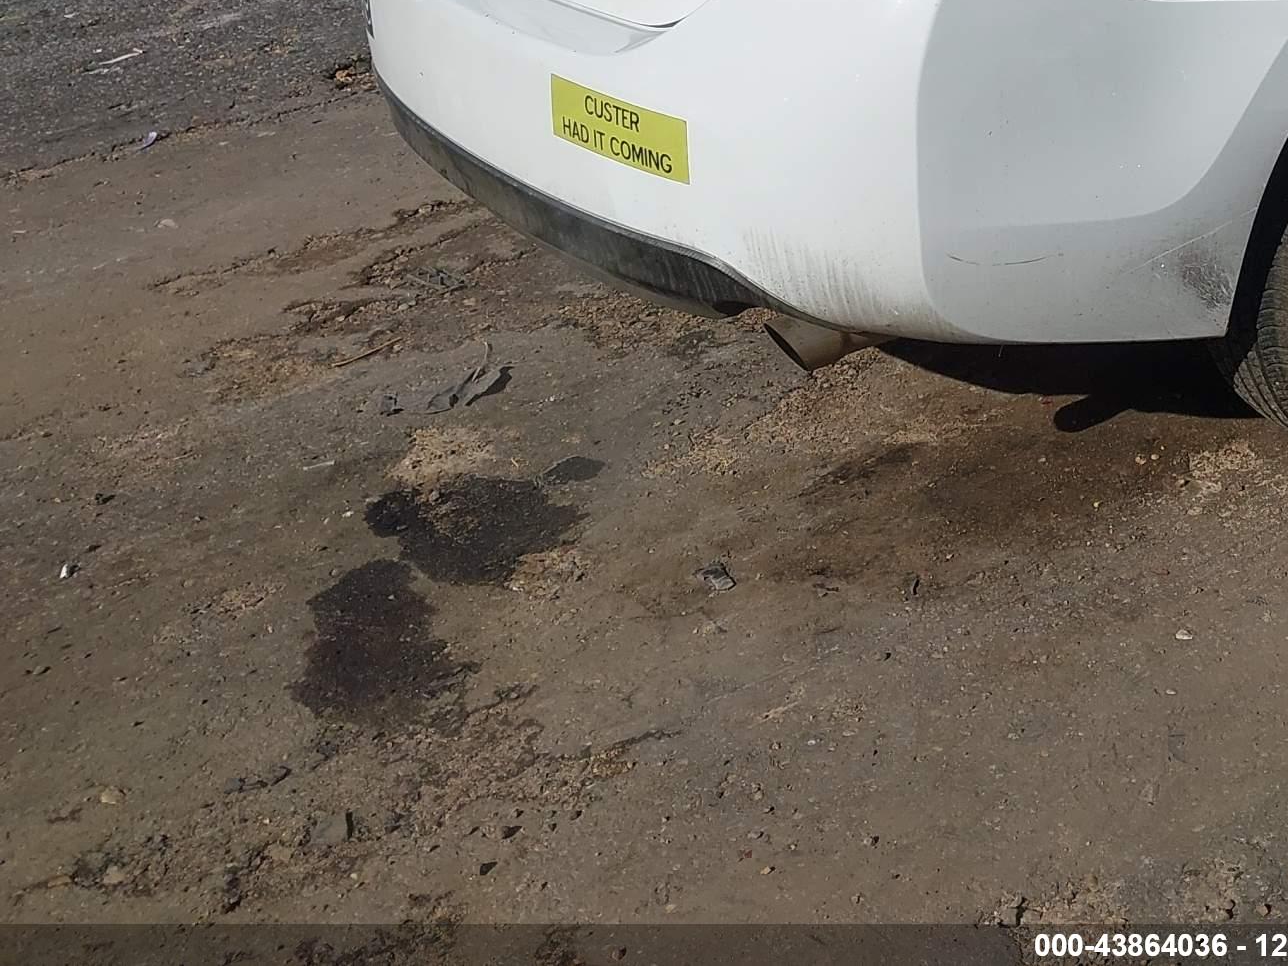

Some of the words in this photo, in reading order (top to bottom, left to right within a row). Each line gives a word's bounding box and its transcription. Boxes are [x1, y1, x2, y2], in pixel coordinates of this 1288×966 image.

[584, 95, 640, 133] CUSTER
[562, 116, 590, 144] HAD
[593, 129, 606, 151] IT
[610, 136, 673, 174] COMING
